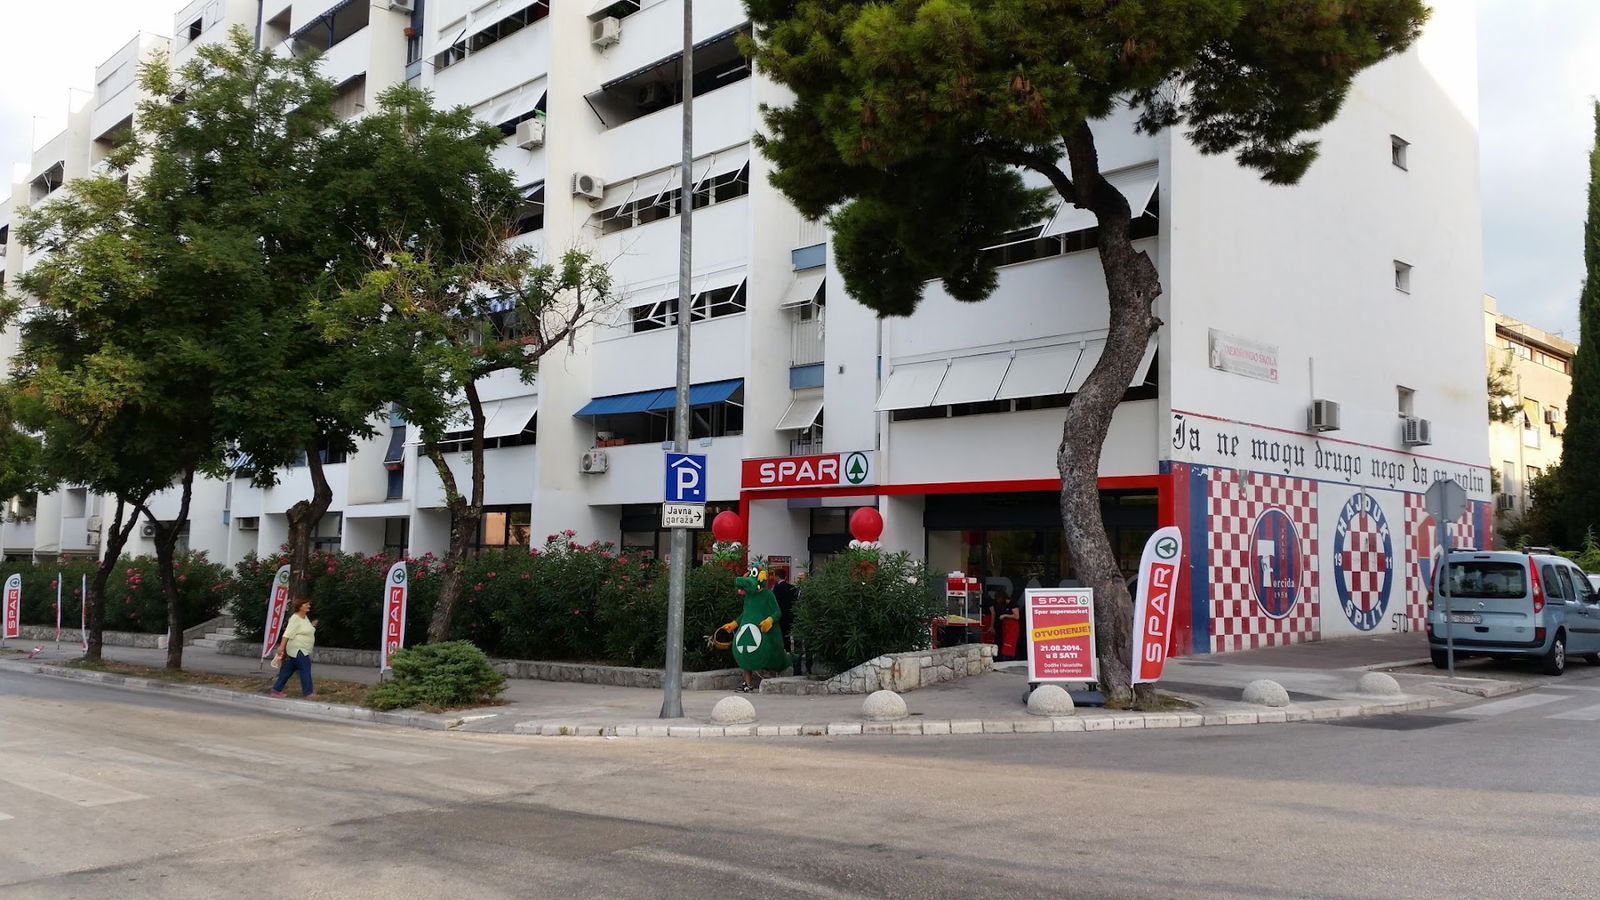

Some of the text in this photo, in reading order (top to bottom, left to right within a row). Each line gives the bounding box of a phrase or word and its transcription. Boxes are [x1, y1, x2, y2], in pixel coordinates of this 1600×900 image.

[1172, 414, 1200, 451] Ja
[1217, 432, 1239, 457] ne
[1251, 438, 1304, 474] mogu
[1314, 440, 1361, 482] drugo
[1371, 458, 1405, 488] nego
[1412, 458, 1428, 485] da
[759, 458, 838, 484] SPAR
[667, 506, 692, 515] Javna
[1337, 493, 1390, 541] HAJDUK
[665, 516, 694, 526] garaža
[1334, 552, 1343, 567] 19
[1385, 557, 1393, 569] 11
[8, 590, 18, 629] SPAR
[1038, 597, 1077, 605] SPAR
[388, 589, 402, 655] SPAR
[1050, 608, 1088, 616] supermarket
[1146, 567, 1171, 663] SPAR
[1345, 600, 1385, 630] SPLIT
[1034, 625, 1091, 639] OTVORENJE!
